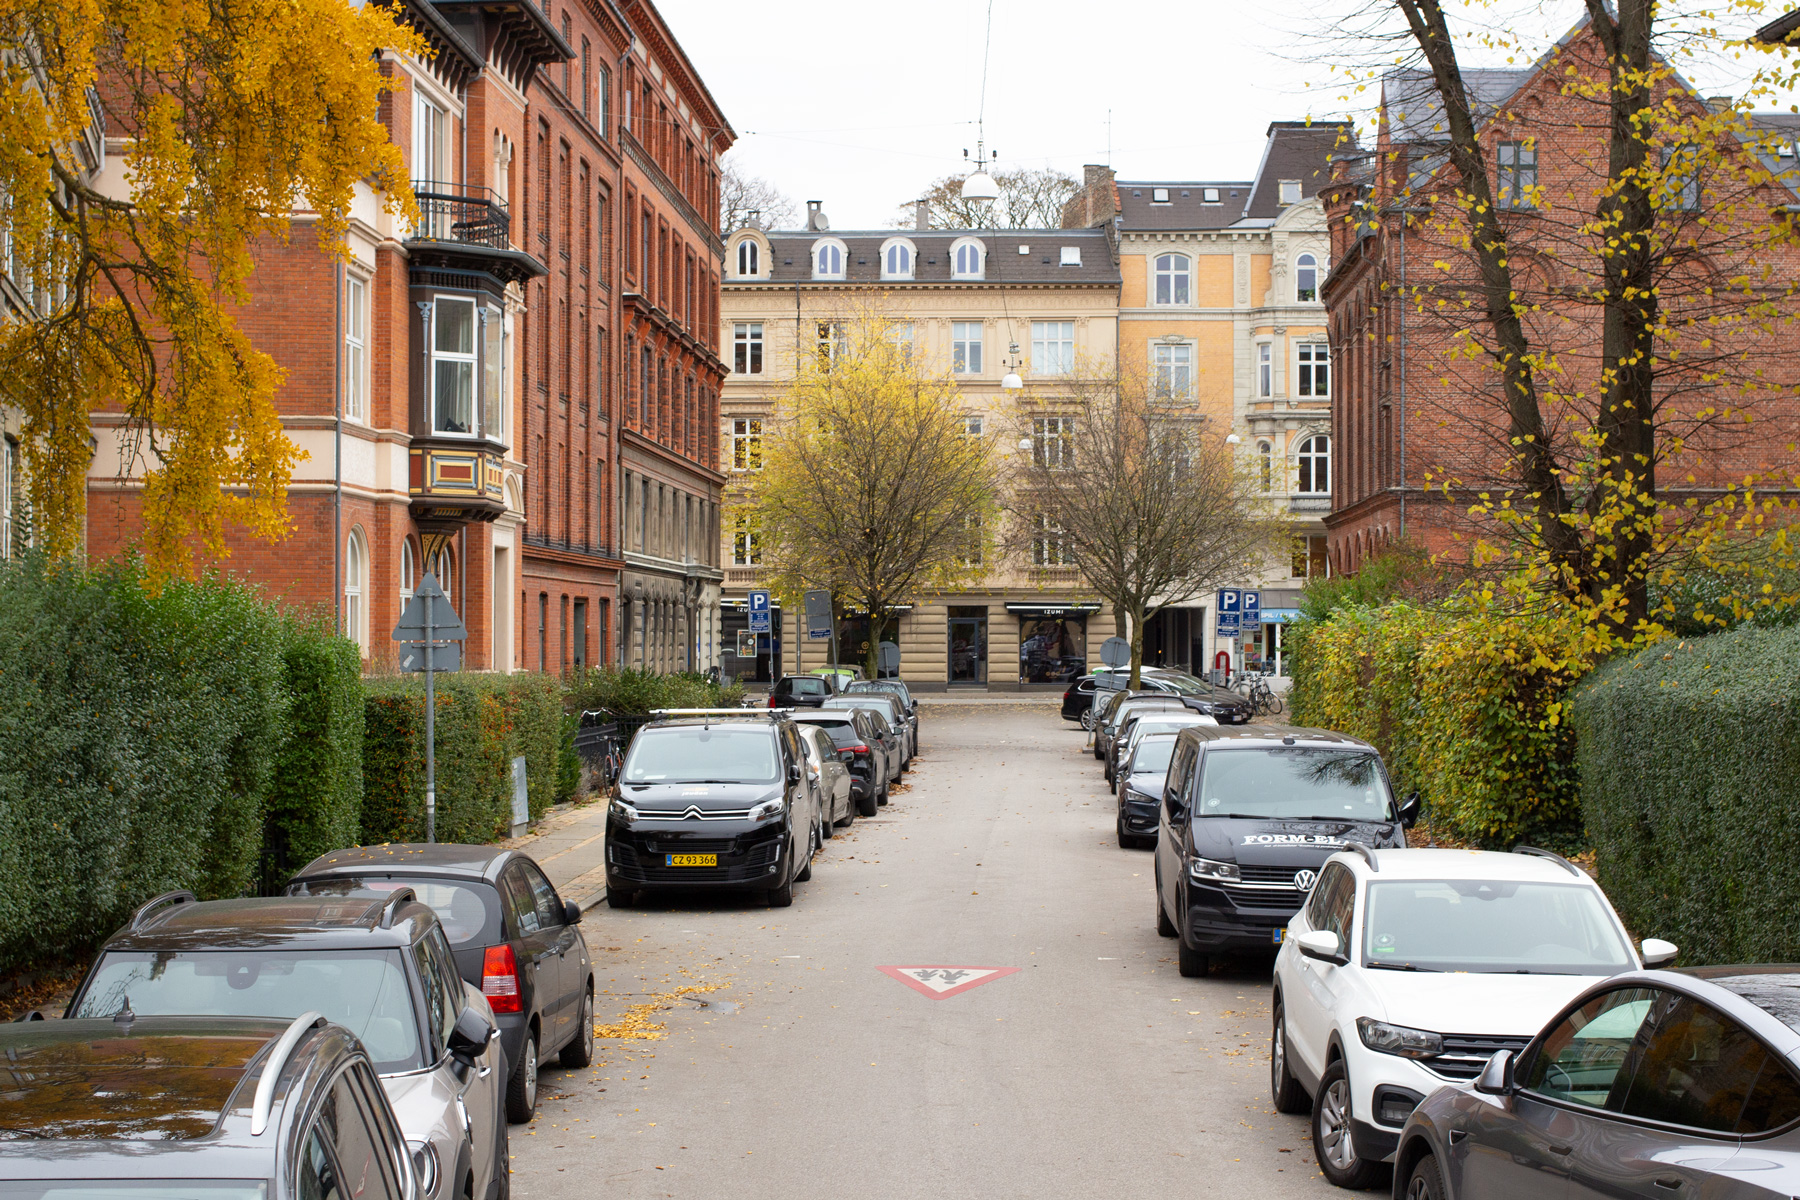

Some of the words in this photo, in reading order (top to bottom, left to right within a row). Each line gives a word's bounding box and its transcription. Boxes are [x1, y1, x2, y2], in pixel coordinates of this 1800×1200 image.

[754, 594, 765, 609] P
[1224, 592, 1237, 609] P
[1245, 594, 1256, 608] P
[672, 856, 684, 864] CZ
[686, 856, 697, 864] 93
[699, 856, 716, 864] 366
